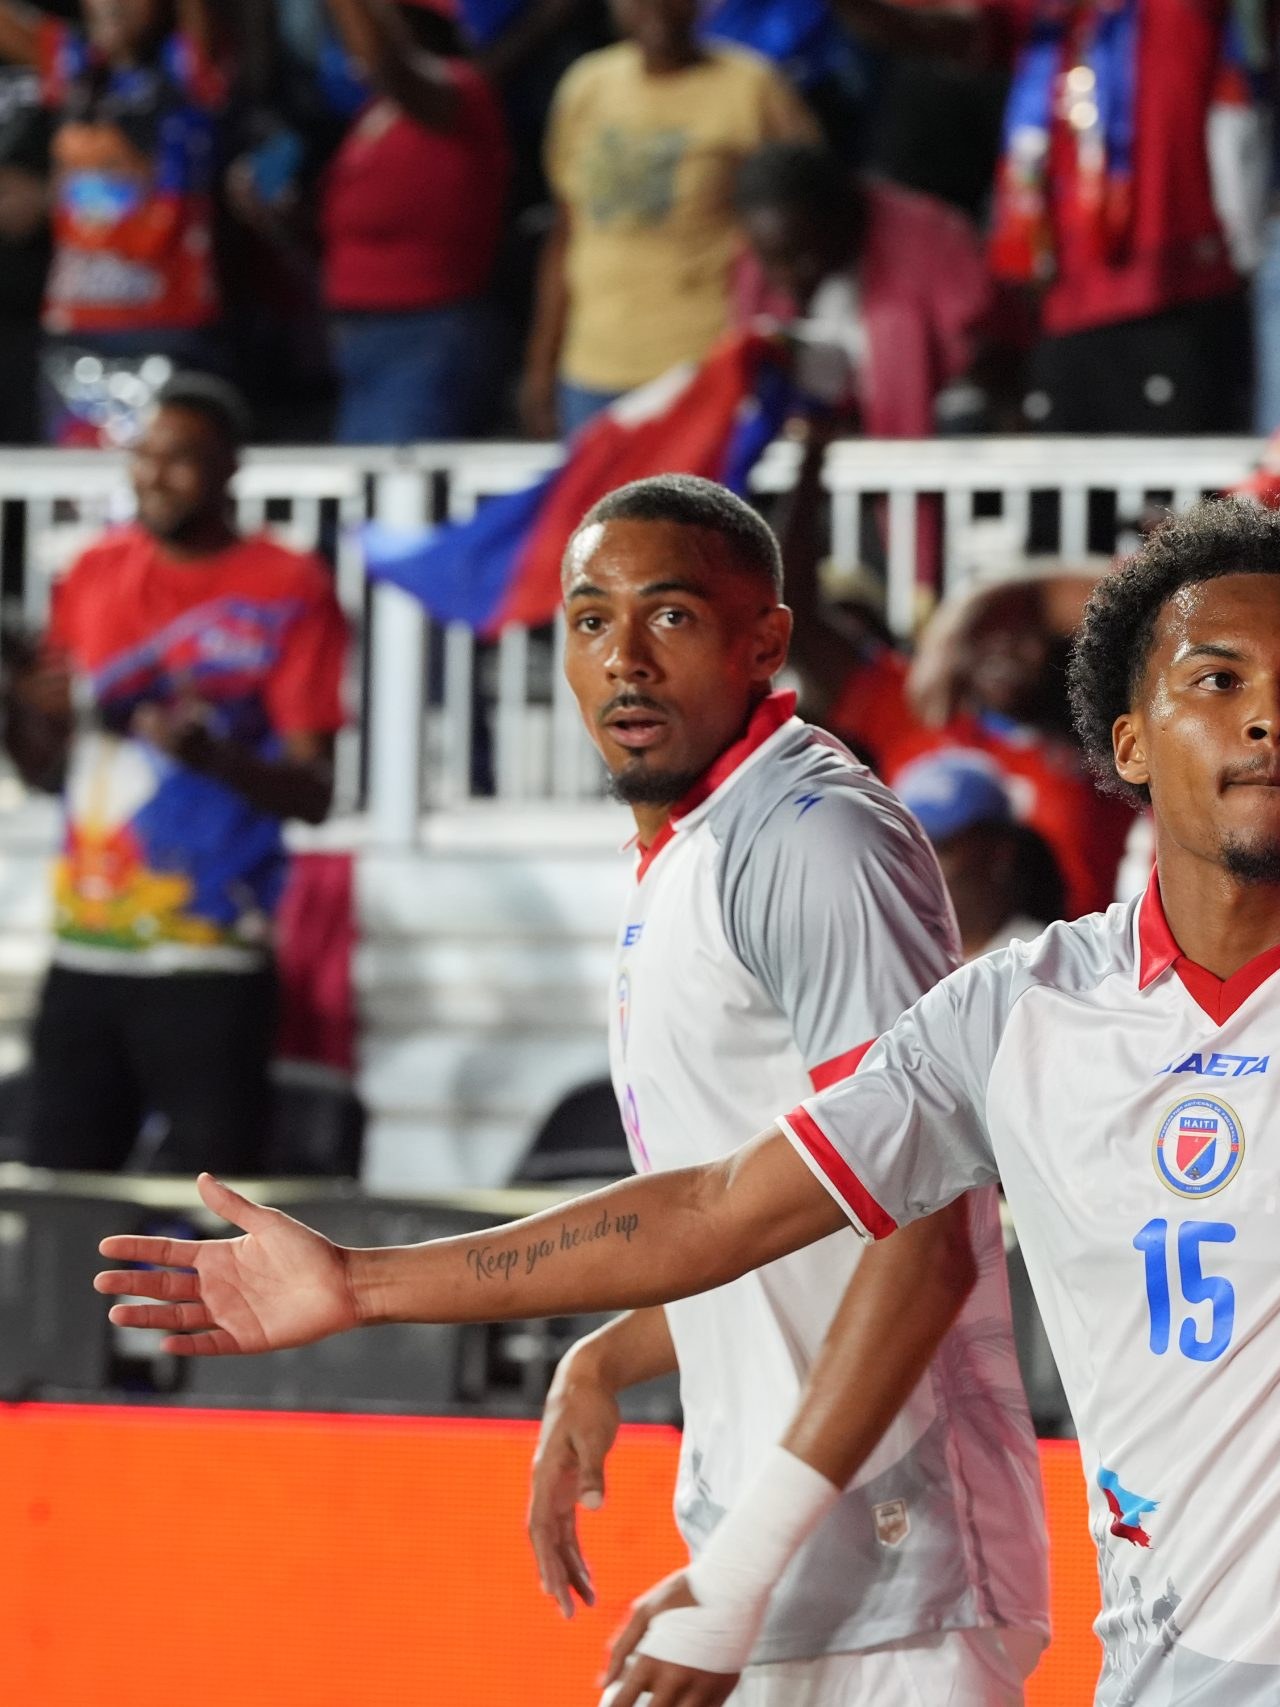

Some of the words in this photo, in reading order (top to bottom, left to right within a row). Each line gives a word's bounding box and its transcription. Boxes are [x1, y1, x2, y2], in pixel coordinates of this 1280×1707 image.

[1183, 1119, 1214, 1129] HAITI
[466, 1245, 519, 1281] Keep
[559, 1209, 611, 1252] head
[615, 1211, 639, 1243] up
[1132, 1218, 1237, 1363] 15
